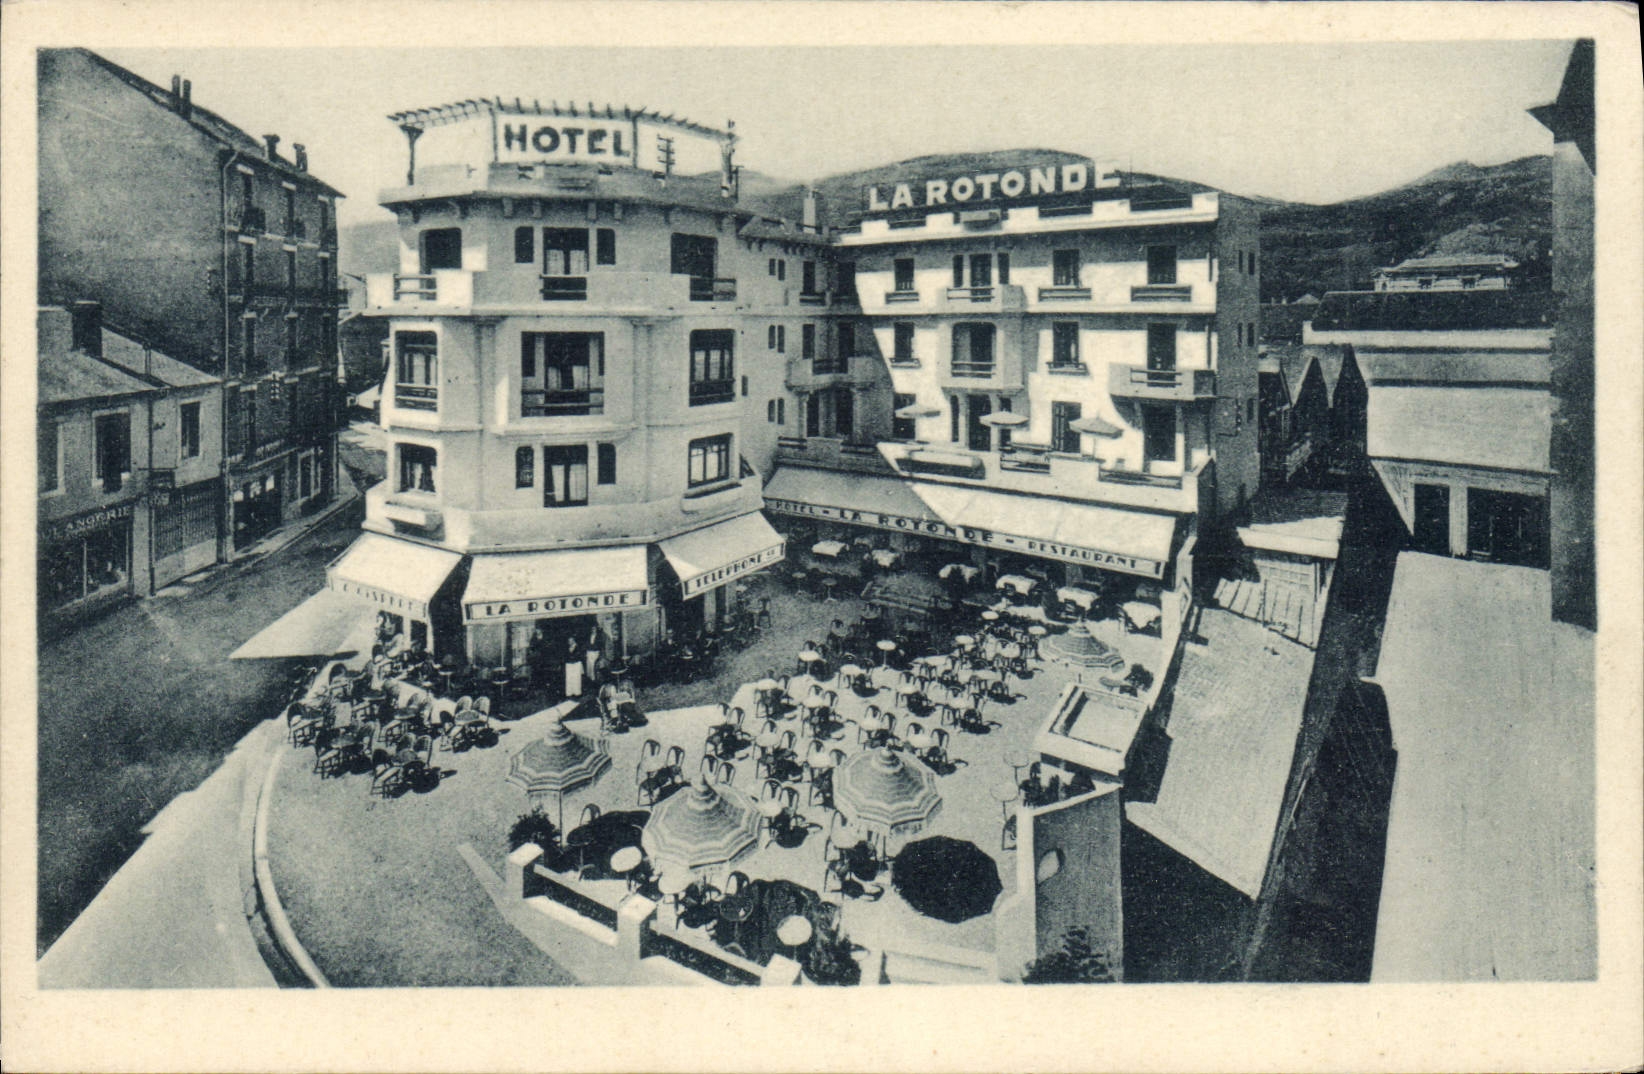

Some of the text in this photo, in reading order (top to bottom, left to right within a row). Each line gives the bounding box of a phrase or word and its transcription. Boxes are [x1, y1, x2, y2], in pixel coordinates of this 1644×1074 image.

[504, 124, 631, 157] HOTEL
[868, 184, 914, 211] LA
[775, 500, 815, 515] HOTEL
[840, 508, 862, 522] LA
[878, 513, 993, 543] ROTONDE
[1028, 541, 1138, 569] RESTAURANT
[696, 554, 762, 588] TELEPHONE
[486, 592, 629, 616] LA ROTONDE
